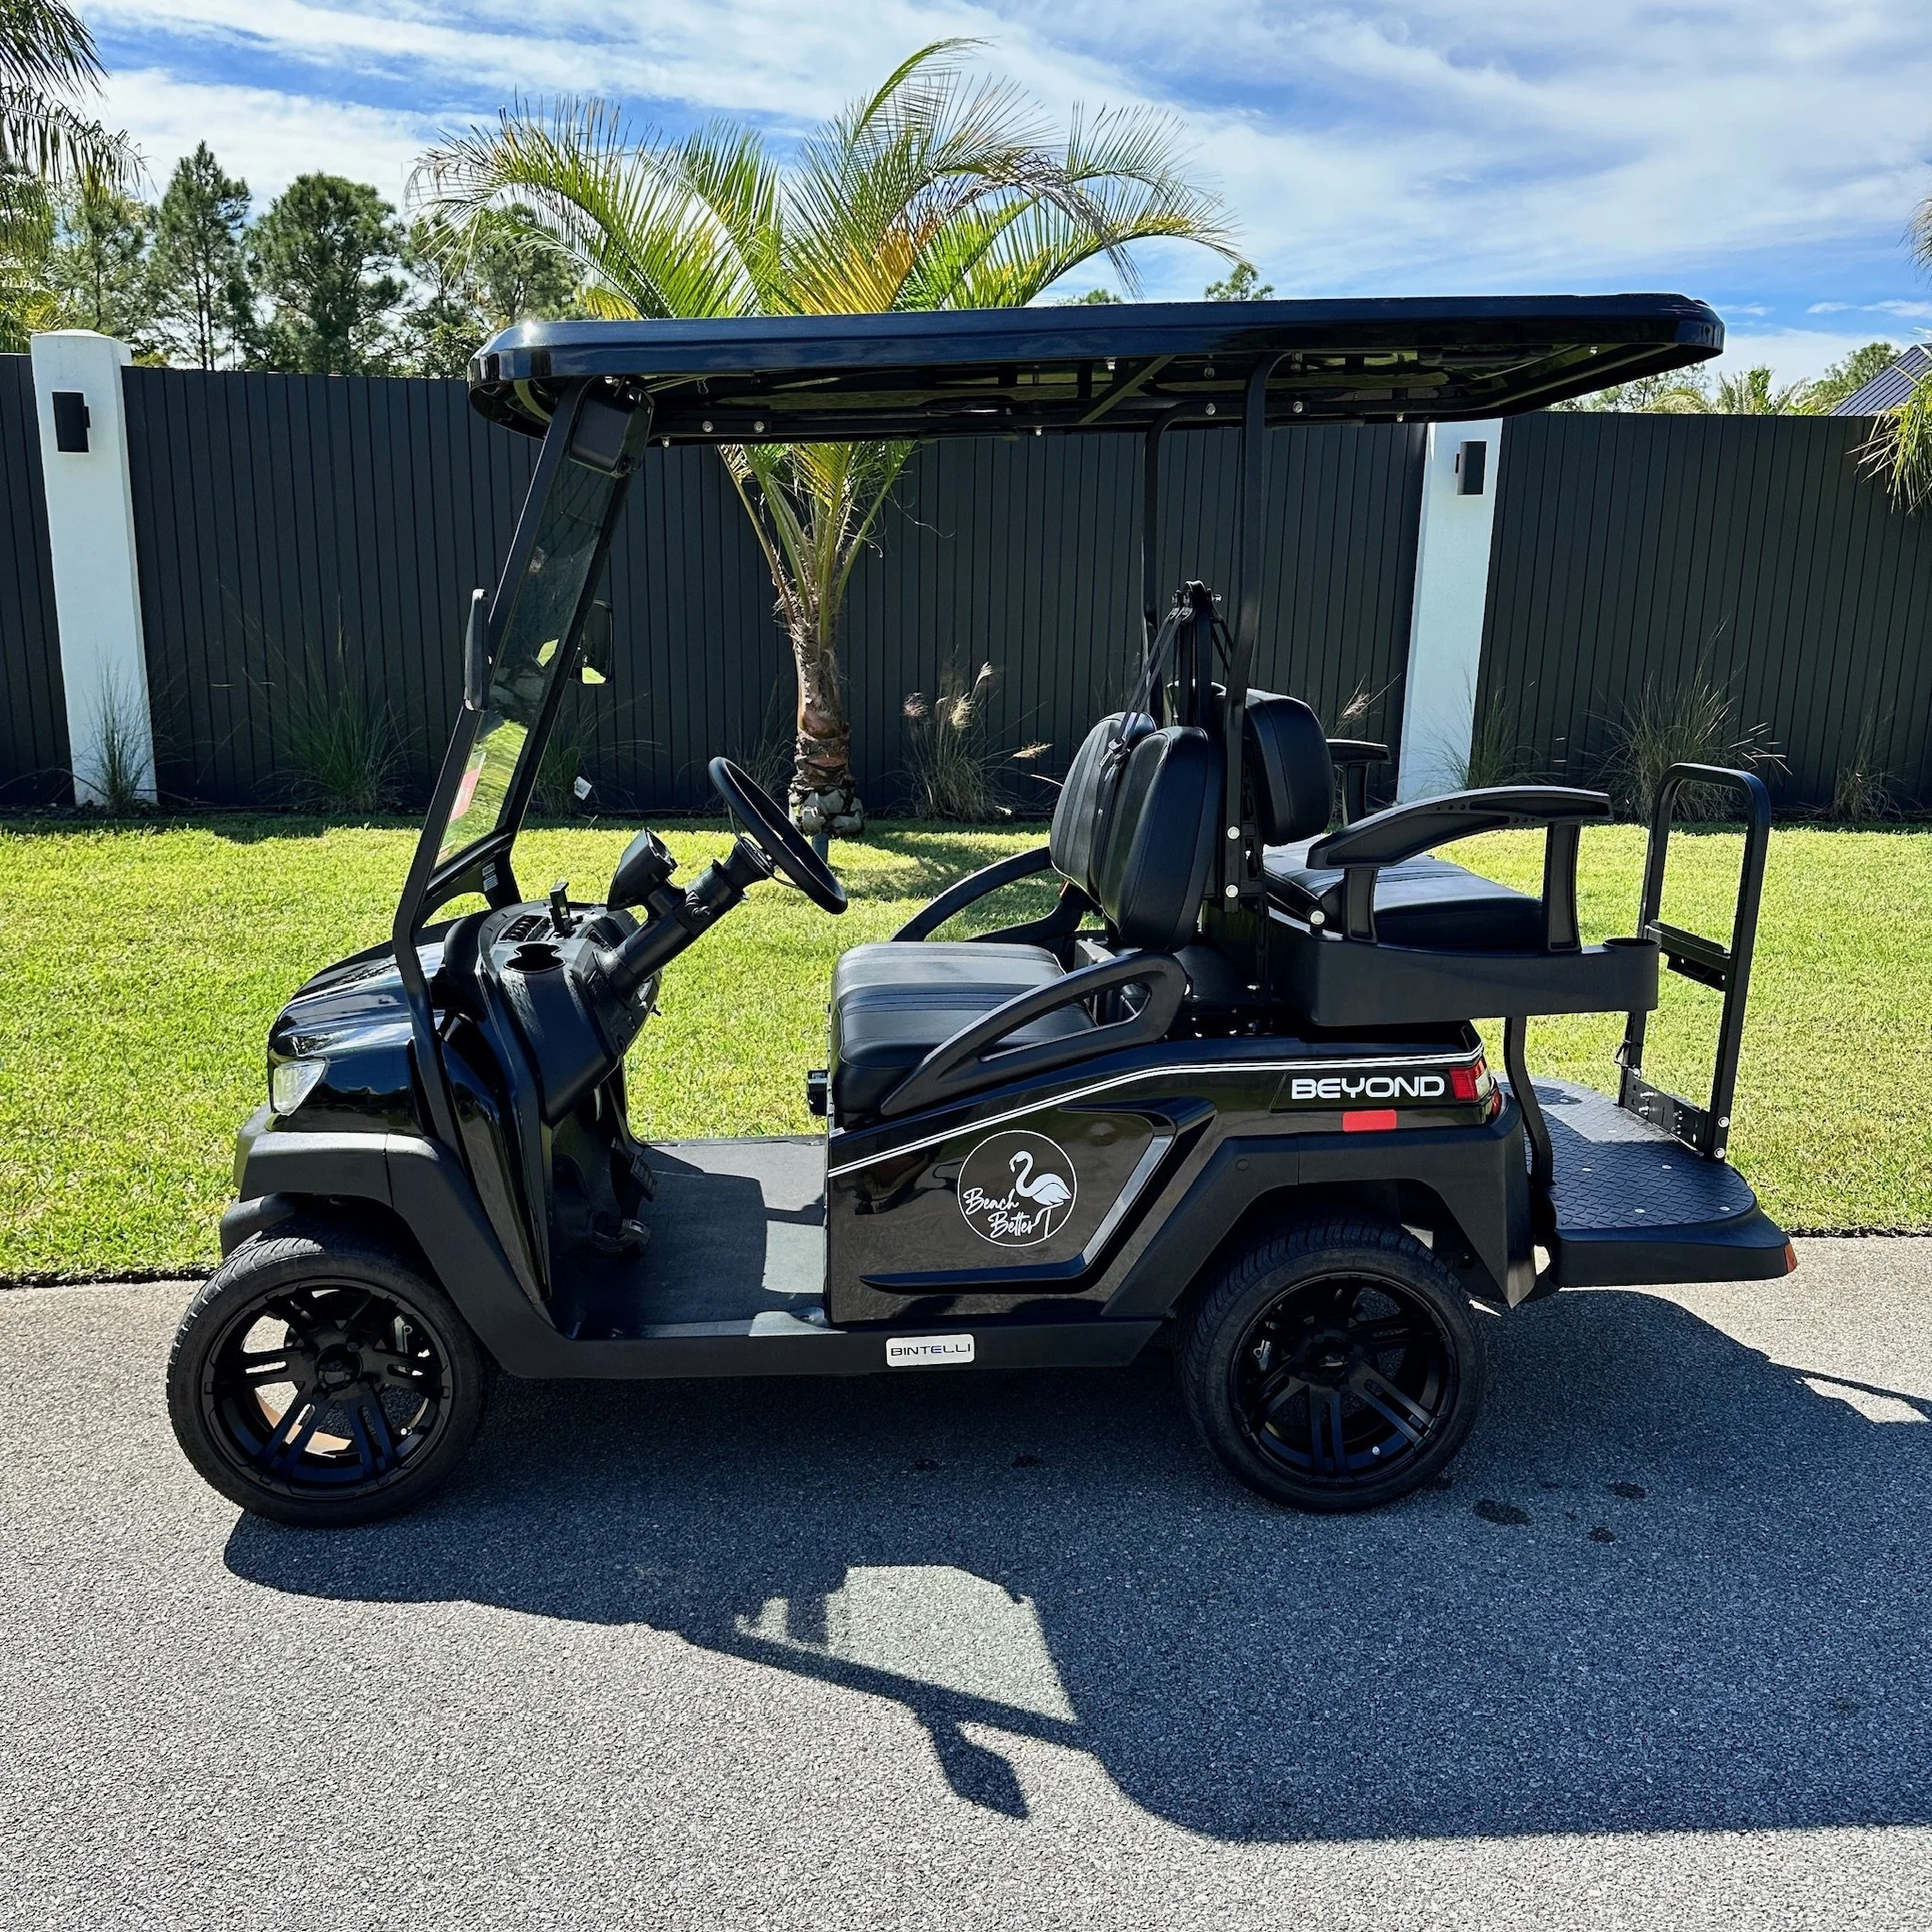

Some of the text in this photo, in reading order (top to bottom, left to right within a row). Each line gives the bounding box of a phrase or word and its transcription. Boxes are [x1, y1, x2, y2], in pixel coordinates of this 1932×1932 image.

[1291, 1075, 1445, 1100] BEYOND
[962, 1187, 1020, 1215] Beach
[987, 1210, 1036, 1239] Better
[890, 1343, 971, 1357] BINTELLI
